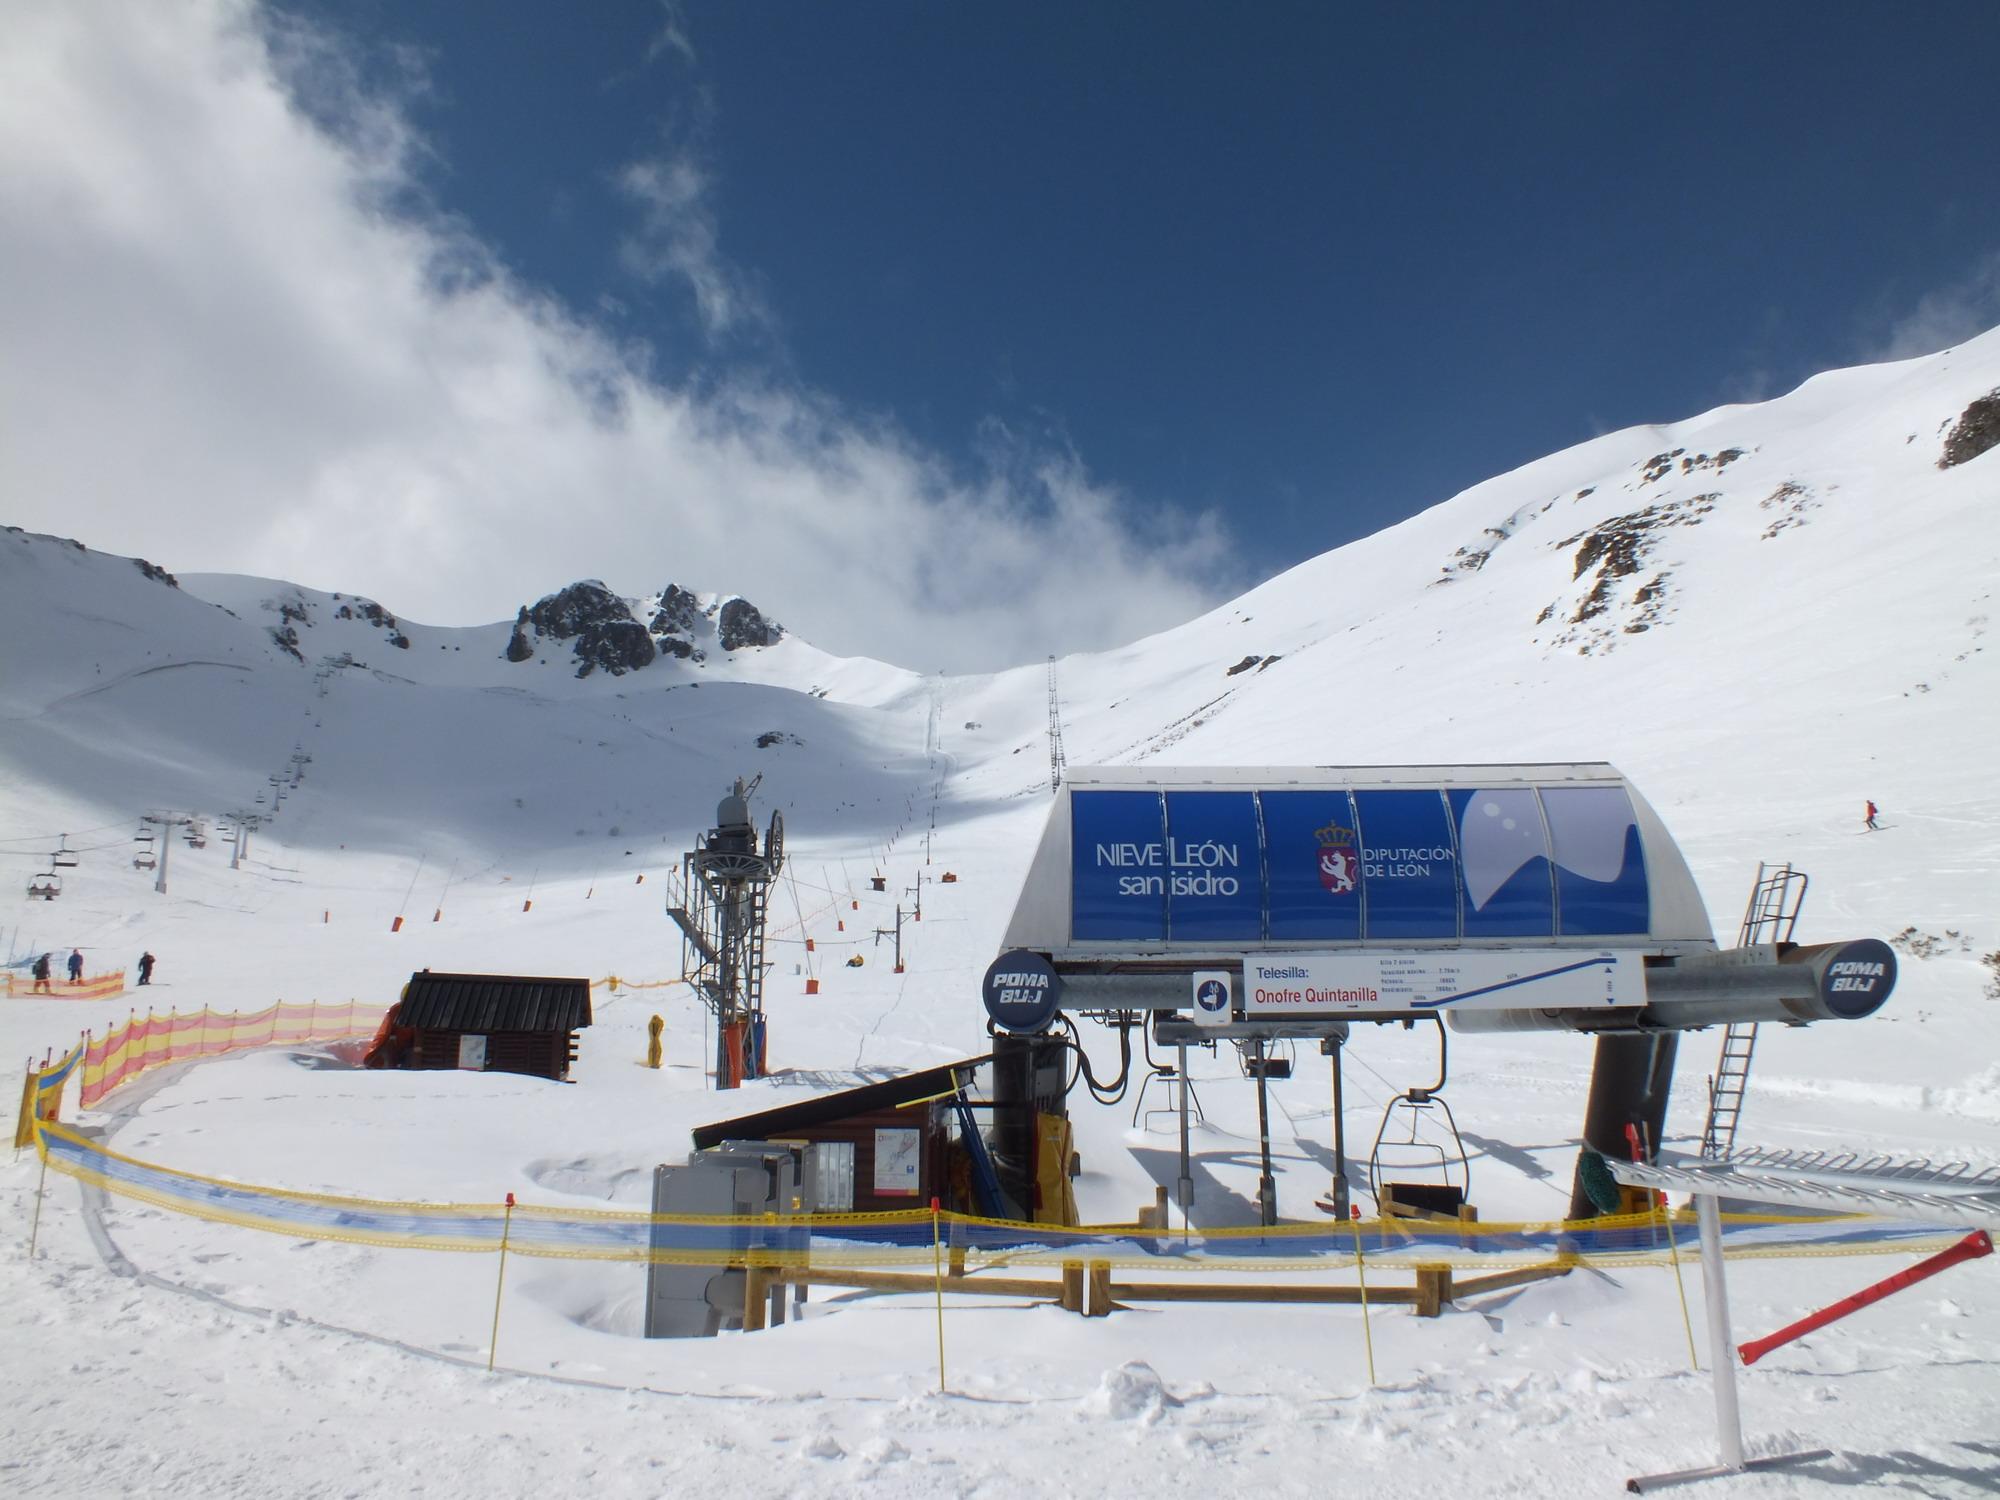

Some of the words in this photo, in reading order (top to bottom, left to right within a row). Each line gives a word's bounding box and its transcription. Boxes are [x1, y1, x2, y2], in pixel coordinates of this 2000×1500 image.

[1097, 843, 1163, 866] NIEVE
[1169, 836, 1239, 867] LEÓN
[1363, 845, 1455, 861] DIPUTACIÓN
[1365, 864, 1385, 877] DE
[1389, 860, 1430, 877] LEÓN
[1119, 876, 1164, 895] san
[1170, 869, 1239, 896] isidro
[1256, 966, 1309, 979] Telesilla:
[1829, 962, 1884, 976] POMA
[992, 973, 1048, 988] POMA
[1831, 978, 1876, 992] BUJ
[1000, 989, 1042, 1004] BUJ
[1255, 989, 1301, 1004] Onofre
[1305, 987, 1378, 1003] Quintanilla
